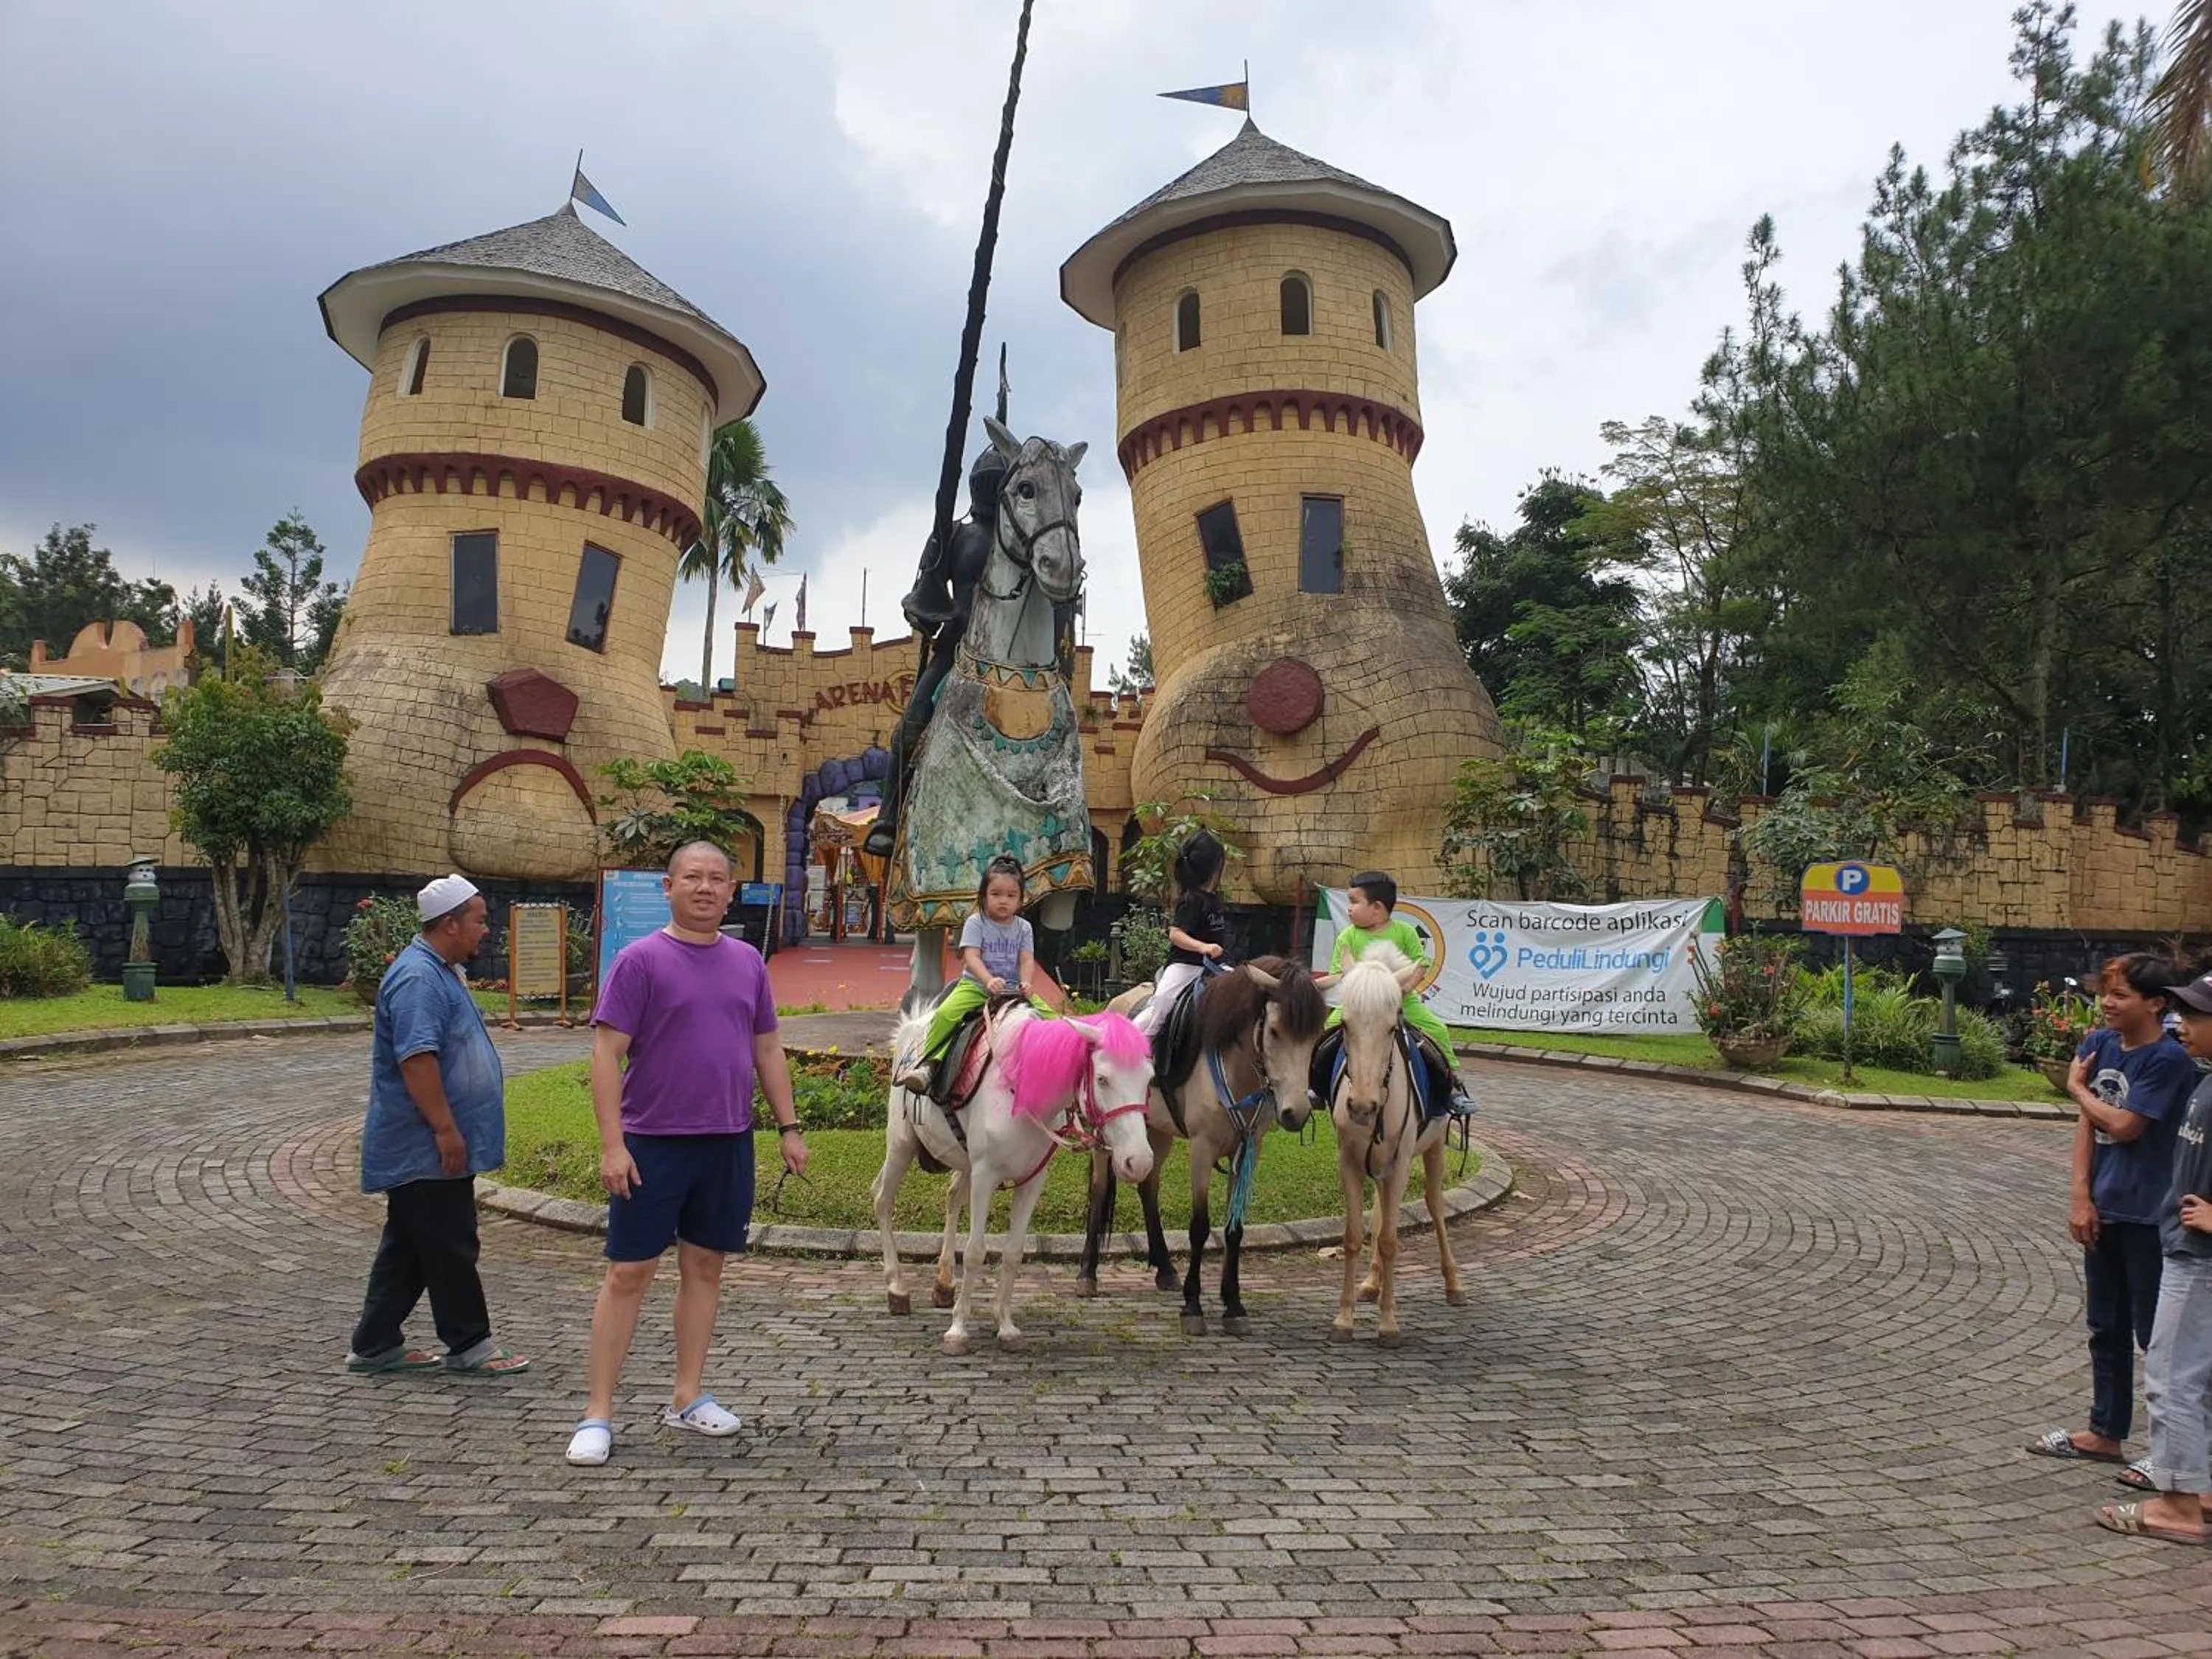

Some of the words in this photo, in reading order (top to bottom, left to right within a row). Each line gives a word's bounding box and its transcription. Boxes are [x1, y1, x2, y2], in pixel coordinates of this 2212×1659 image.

[815, 681, 897, 709] ARENA
[1842, 869, 1862, 891] P
[1467, 909, 1512, 928] Scan
[1519, 911, 1601, 931] barcode
[1607, 910, 1688, 934] aplikasi
[1806, 900, 1850, 922] PARKIR
[1854, 901, 1899, 925] GRATIS
[1517, 947, 1671, 973] PeduliLindungi
[1473, 982, 1526, 1001] Wujud
[1531, 986, 1617, 1006] partisipasi
[1622, 987, 1666, 1003] anda
[1461, 1003, 1555, 1025] melindungi
[1560, 1009, 1603, 1026] yang
[1609, 1008, 1677, 1024] tercinta
